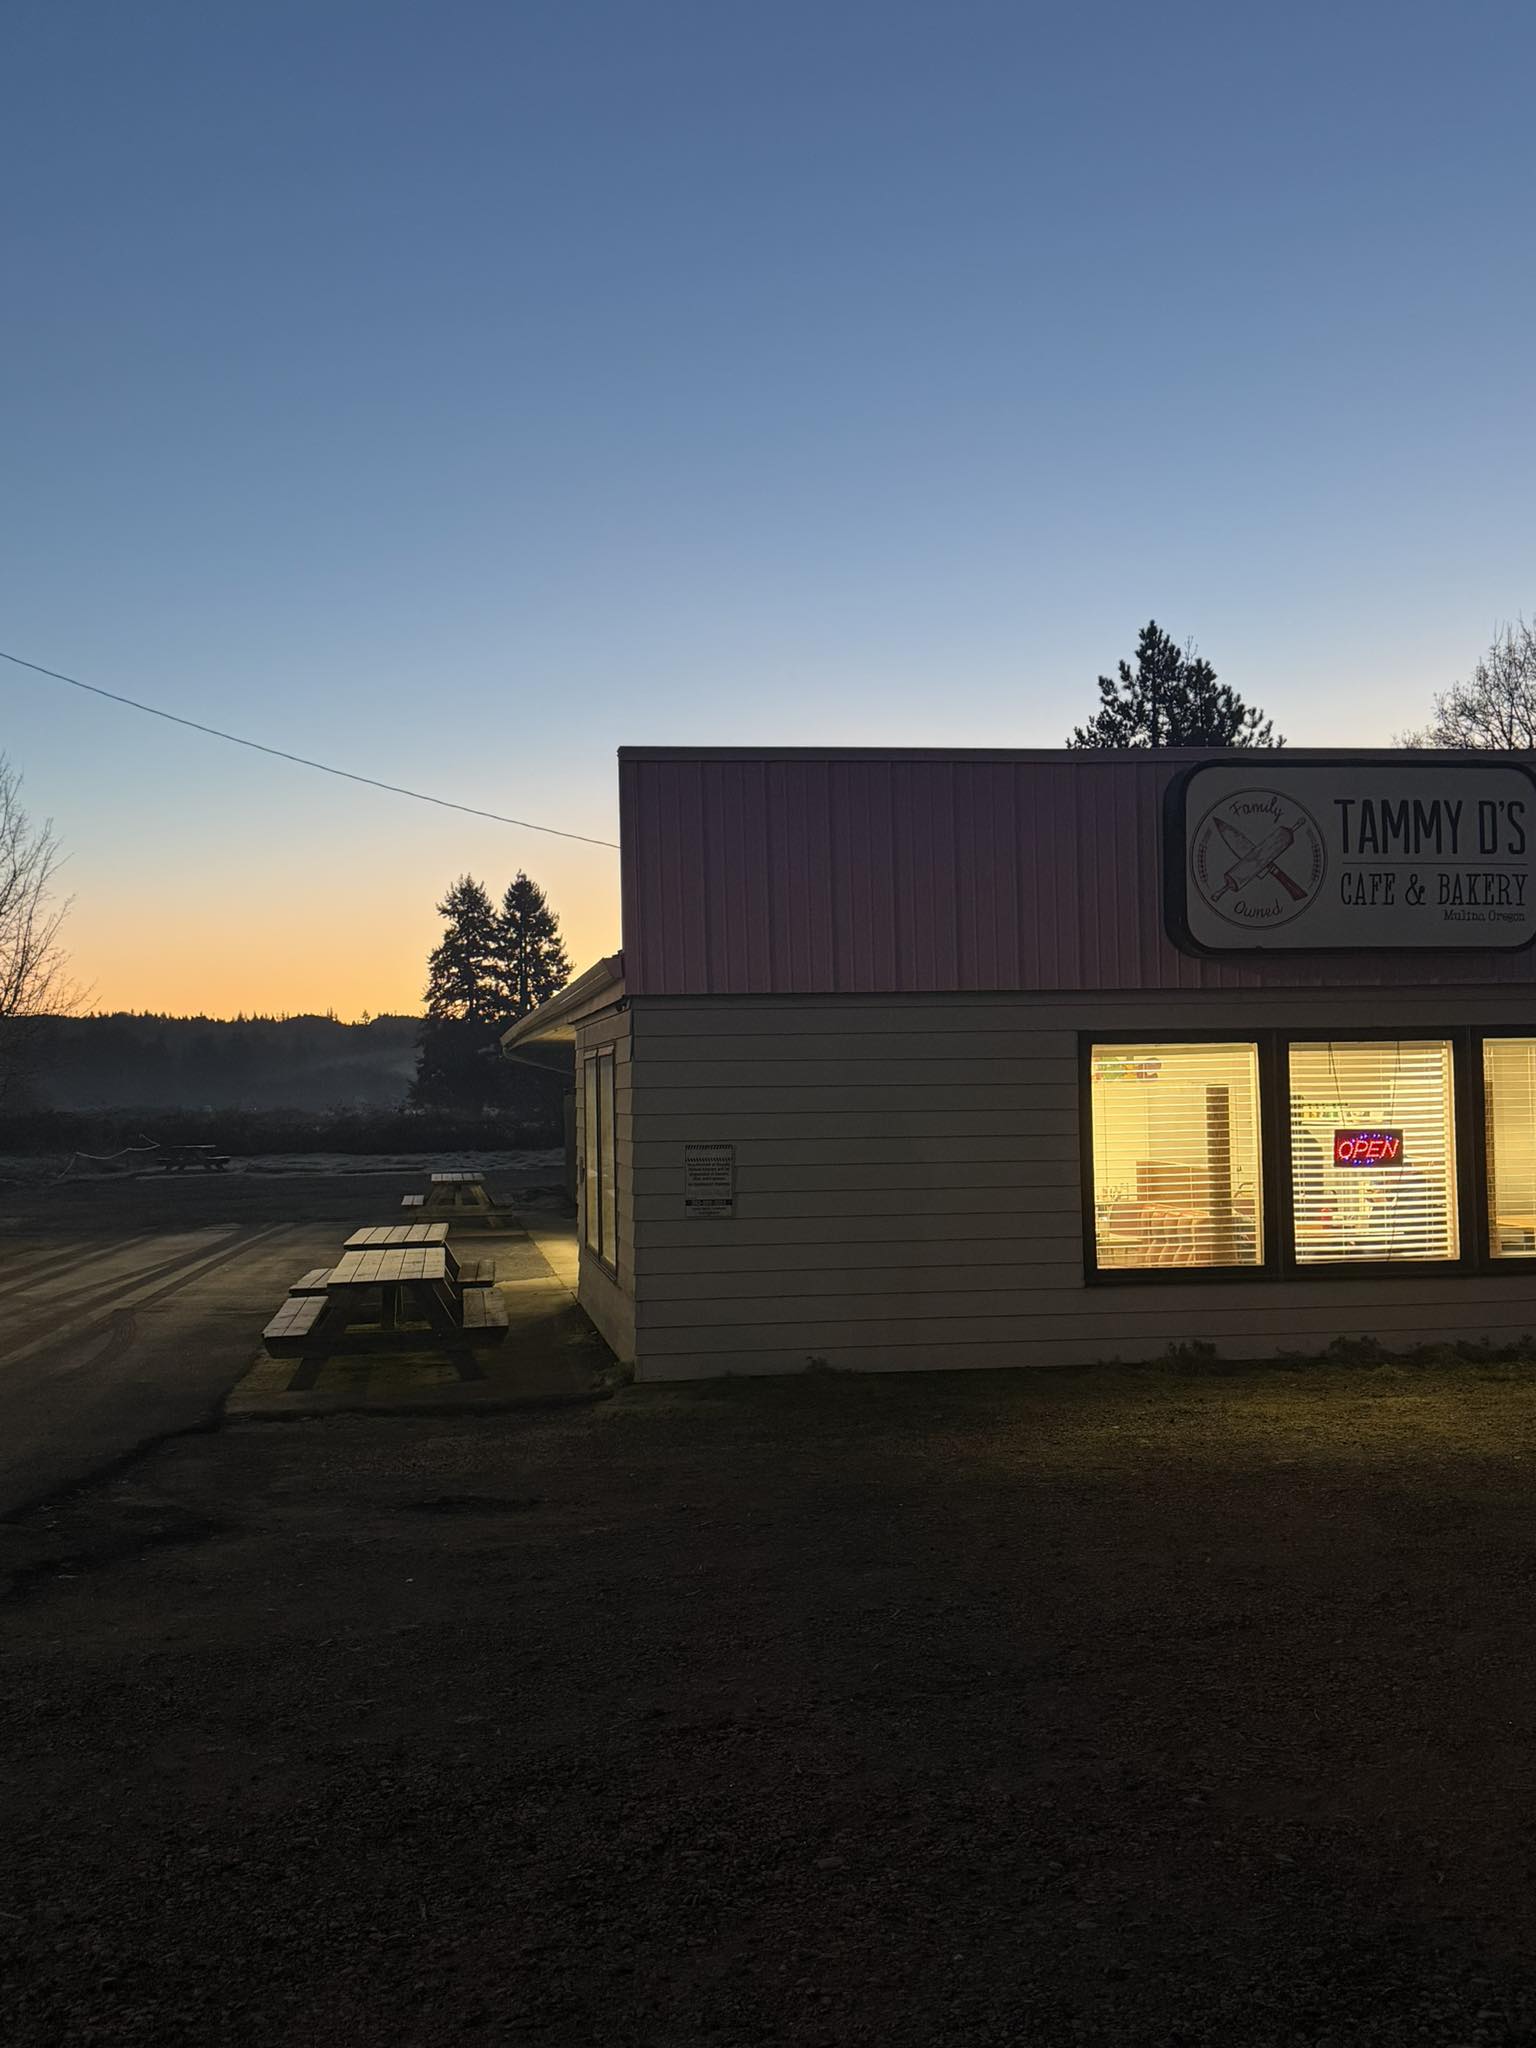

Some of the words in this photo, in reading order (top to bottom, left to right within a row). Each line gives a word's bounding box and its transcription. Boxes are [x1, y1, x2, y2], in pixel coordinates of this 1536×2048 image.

[1230, 797, 1286, 822] Family
[1334, 799, 1463, 854] TAMMY
[1479, 800, 1526, 854] D'S
[1340, 873, 1395, 905] CAFE
[1405, 875, 1426, 906] &
[1437, 873, 1529, 906] BAKERY
[1233, 899, 1284, 918] Owned
[1488, 910, 1526, 923] Oregon
[1338, 1139, 1400, 1160] OPEN
